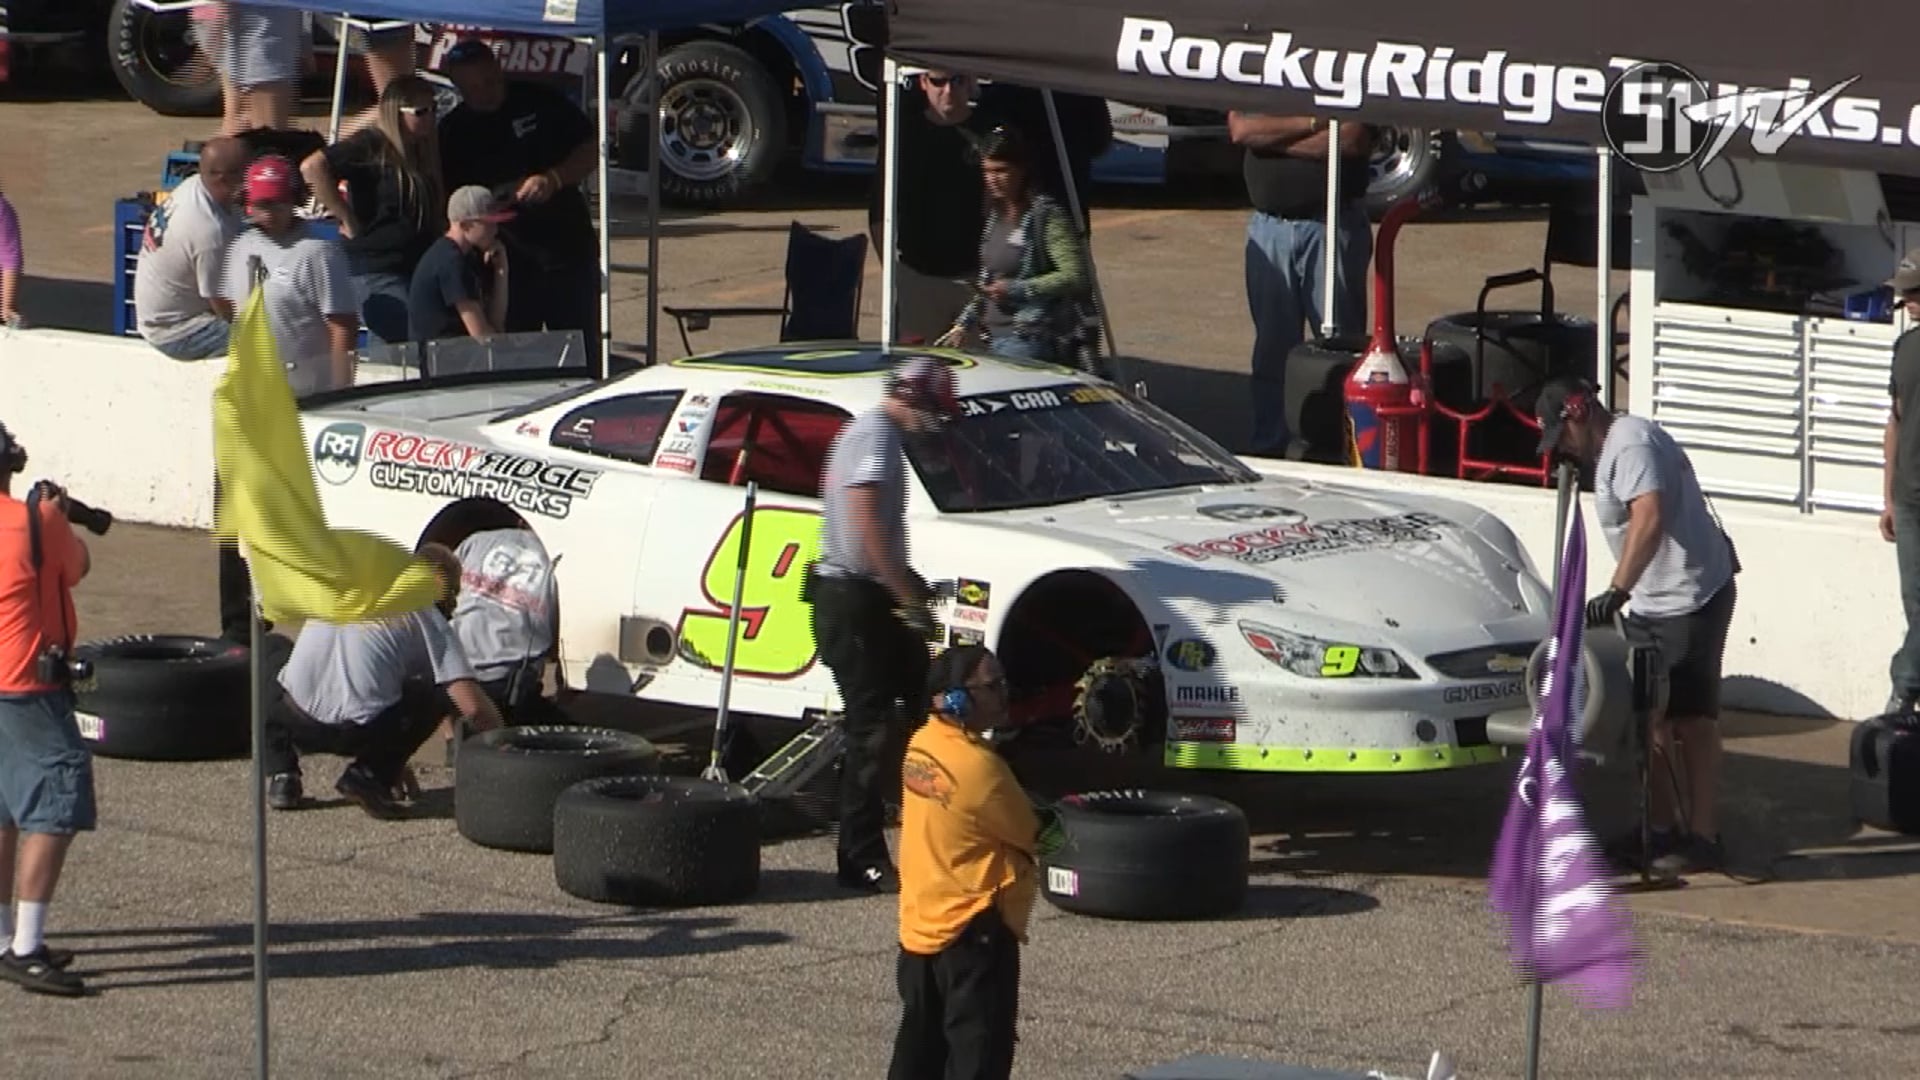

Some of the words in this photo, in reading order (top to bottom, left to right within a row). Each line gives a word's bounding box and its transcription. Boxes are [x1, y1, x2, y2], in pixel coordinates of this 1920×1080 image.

[1009, 390, 1061, 411] CRA
[365, 429, 481, 471] ROCKY
[369, 462, 465, 496] CUSTOM
[465, 474, 575, 519] TRUCKS
[677, 505, 822, 678] 9
[1320, 646, 1360, 677] 9
[1177, 686, 1240, 702] MAHLE
